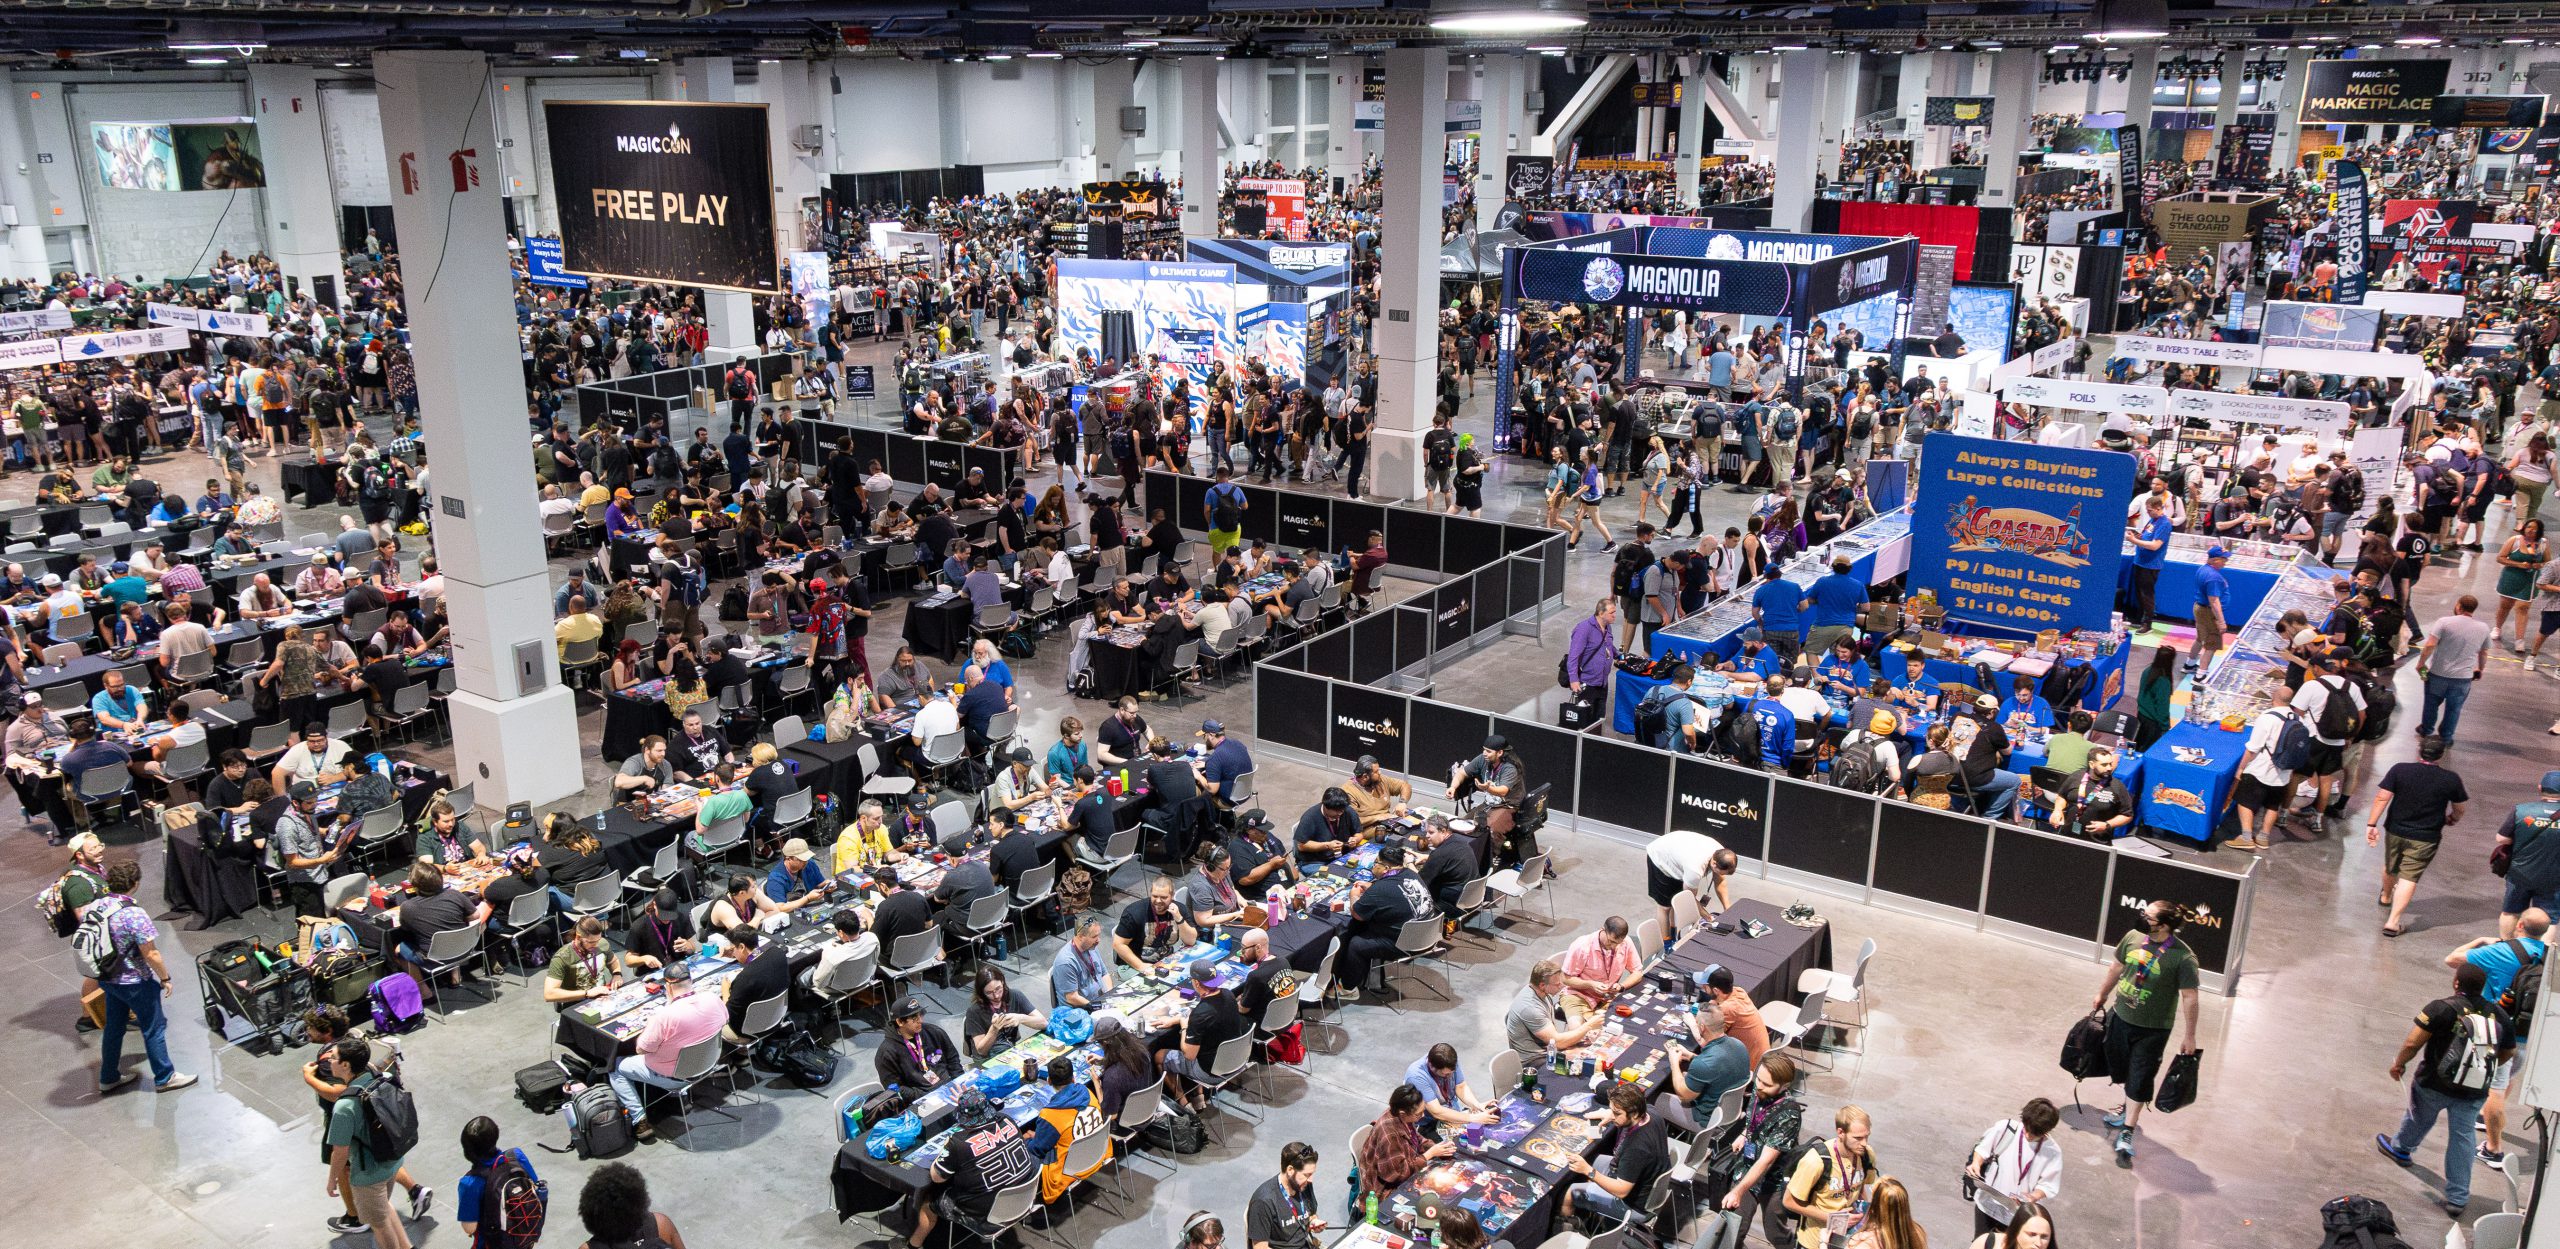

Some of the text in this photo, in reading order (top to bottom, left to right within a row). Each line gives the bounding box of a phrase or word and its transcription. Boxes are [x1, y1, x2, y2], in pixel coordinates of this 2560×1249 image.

[2346, 84, 2400, 96] MAGIC
[2311, 98, 2432, 110] MARKETPLACE
[617, 136, 691, 154] MAGICCON
[2121, 131, 2137, 186] BECKETT
[1517, 162, 1544, 173] Three
[1266, 184, 1274, 192] UP
[1276, 184, 1283, 193] TO
[1285, 185, 1303, 194] 120%
[1517, 181, 1544, 191] Trading
[592, 188, 728, 226] FREE PLAY
[2168, 222, 2230, 232] STANDARD
[2170, 215, 2231, 224] THE GOLD
[2338, 187, 2351, 265] CARDGAME
[2349, 184, 2363, 266] CORNER
[2412, 252, 2446, 263] AULT
[1160, 268, 1228, 278] ULTIMATE GUARD
[1855, 255, 1888, 289] MAGNOLIA
[1627, 265, 1720, 298] MAGNOLIA
[1643, 294, 1703, 305] GAMING
[2156, 343, 2190, 355] BUYER'S
[2193, 346, 2219, 357] TABLE
[2069, 392, 2096, 403] FOILS
[1956, 451, 2098, 478] Always Buying:
[1947, 469, 2104, 498] Large Collections
[1283, 515, 1325, 527] MAGICCON
[1969, 507, 2073, 546] COASTAL
[2000, 538, 2037, 555] MTG
[1946, 558, 2081, 589] P9 / Dual Lands
[1950, 577, 2072, 606] English Cards
[1338, 715, 1399, 737] MAGICCON
[1681, 793, 1758, 820] MAGICCON
